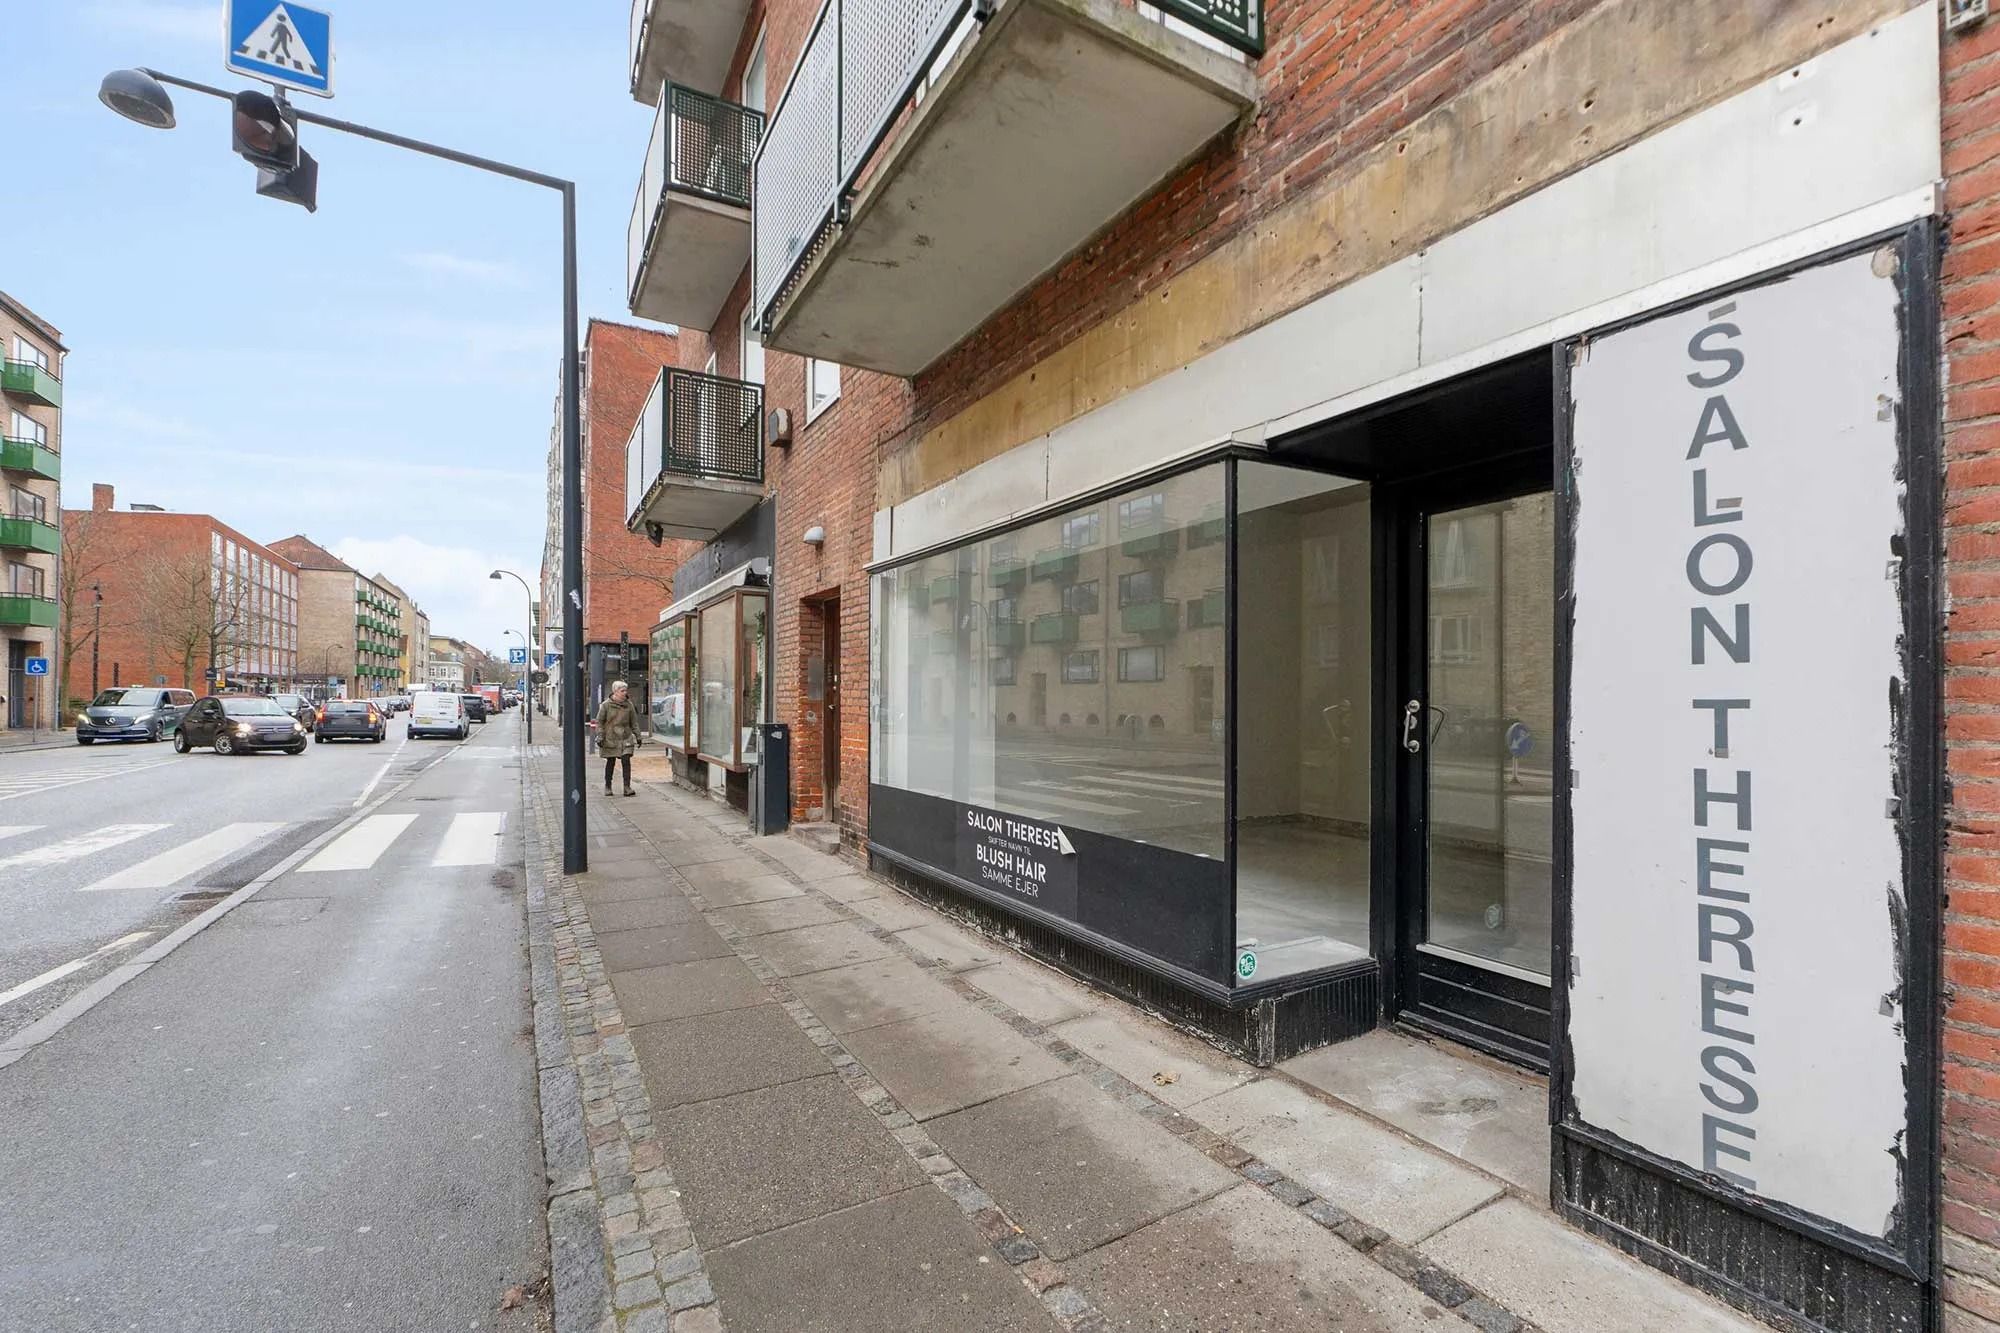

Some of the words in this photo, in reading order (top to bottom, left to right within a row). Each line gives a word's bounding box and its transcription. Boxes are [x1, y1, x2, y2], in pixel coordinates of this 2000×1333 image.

[1686, 322, 1754, 665] SALON
[511, 650, 525, 663] P
[967, 810, 1003, 834] SALON
[1005, 820, 1059, 850] THERESE
[976, 844, 1013, 872] BLUSH
[1016, 856, 1047, 883] HAIR
[982, 865, 1013, 889] SAMME
[1015, 877, 1039, 898] EJER
[1692, 698, 1760, 1190] THERESE
